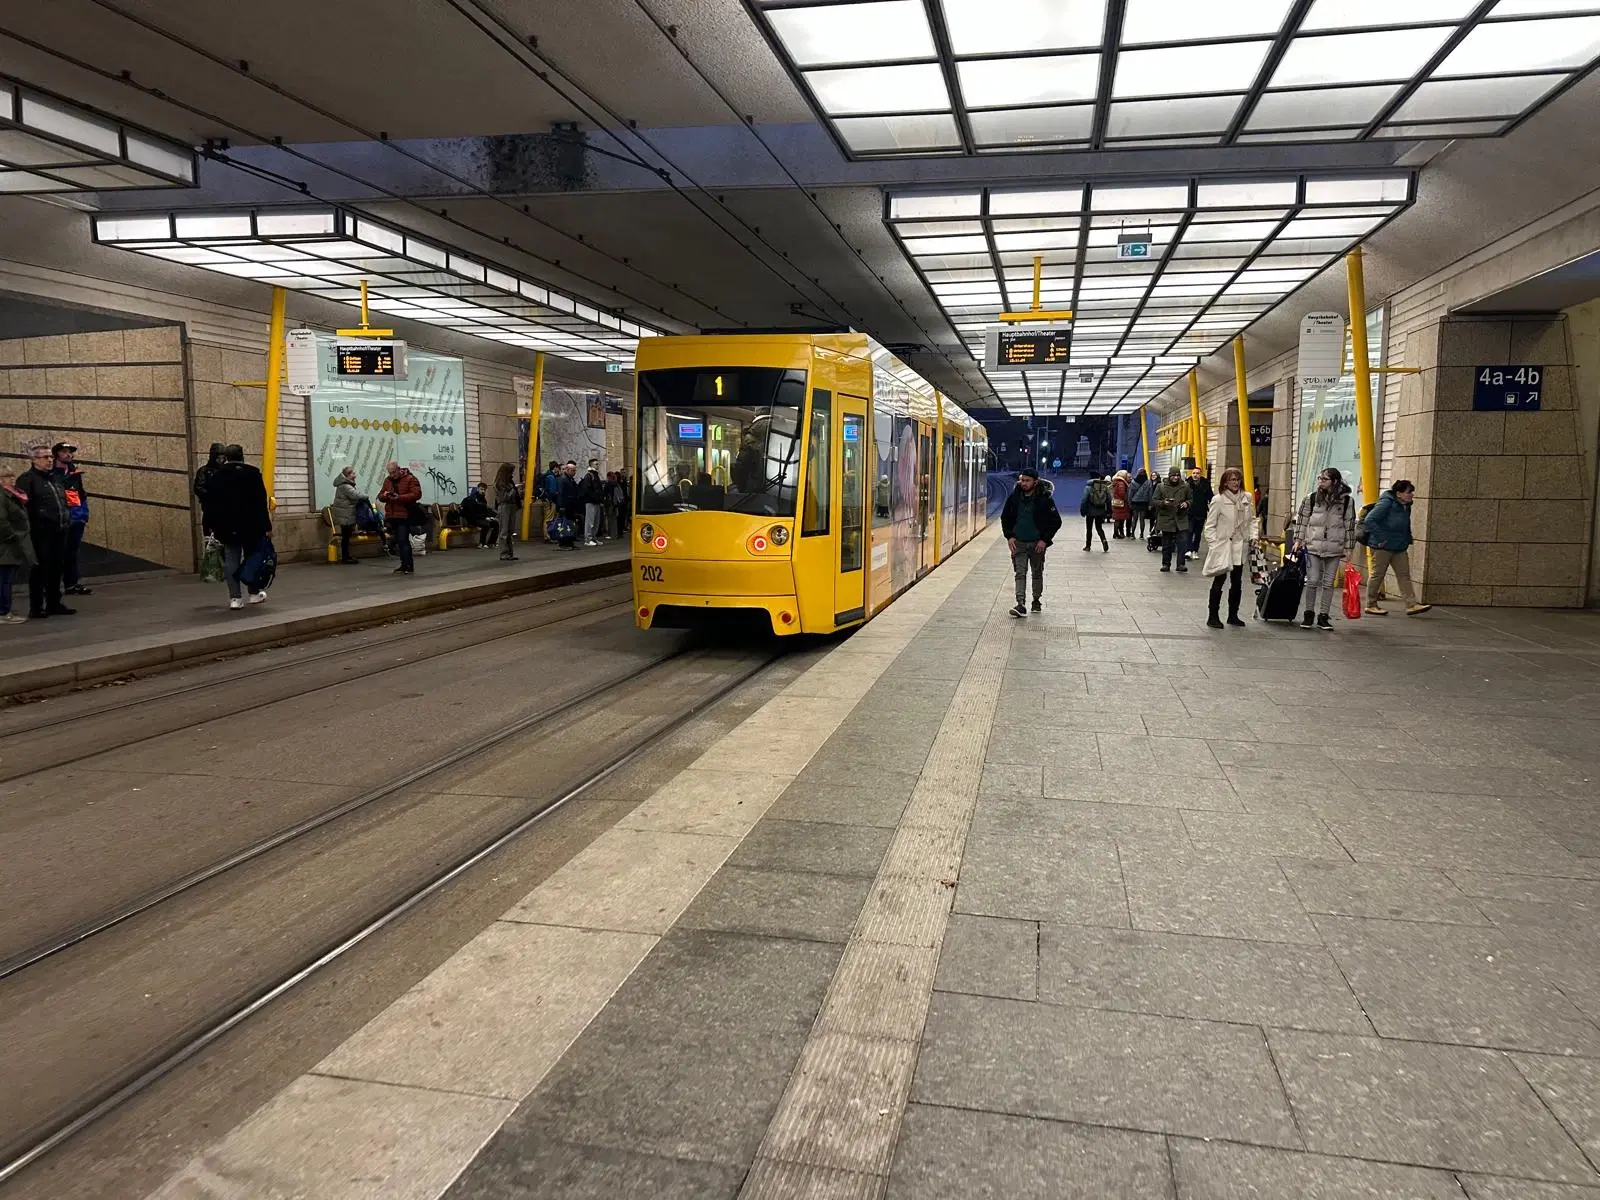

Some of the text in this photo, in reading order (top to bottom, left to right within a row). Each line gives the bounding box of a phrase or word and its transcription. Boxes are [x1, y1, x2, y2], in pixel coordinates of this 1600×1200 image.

[1480, 368, 1540, 385] 4a-4b
[715, 376, 722, 395] 1
[328, 402, 344, 413] Linie
[1251, 426, 1271, 434] a-6b
[641, 565, 664, 582] 202
